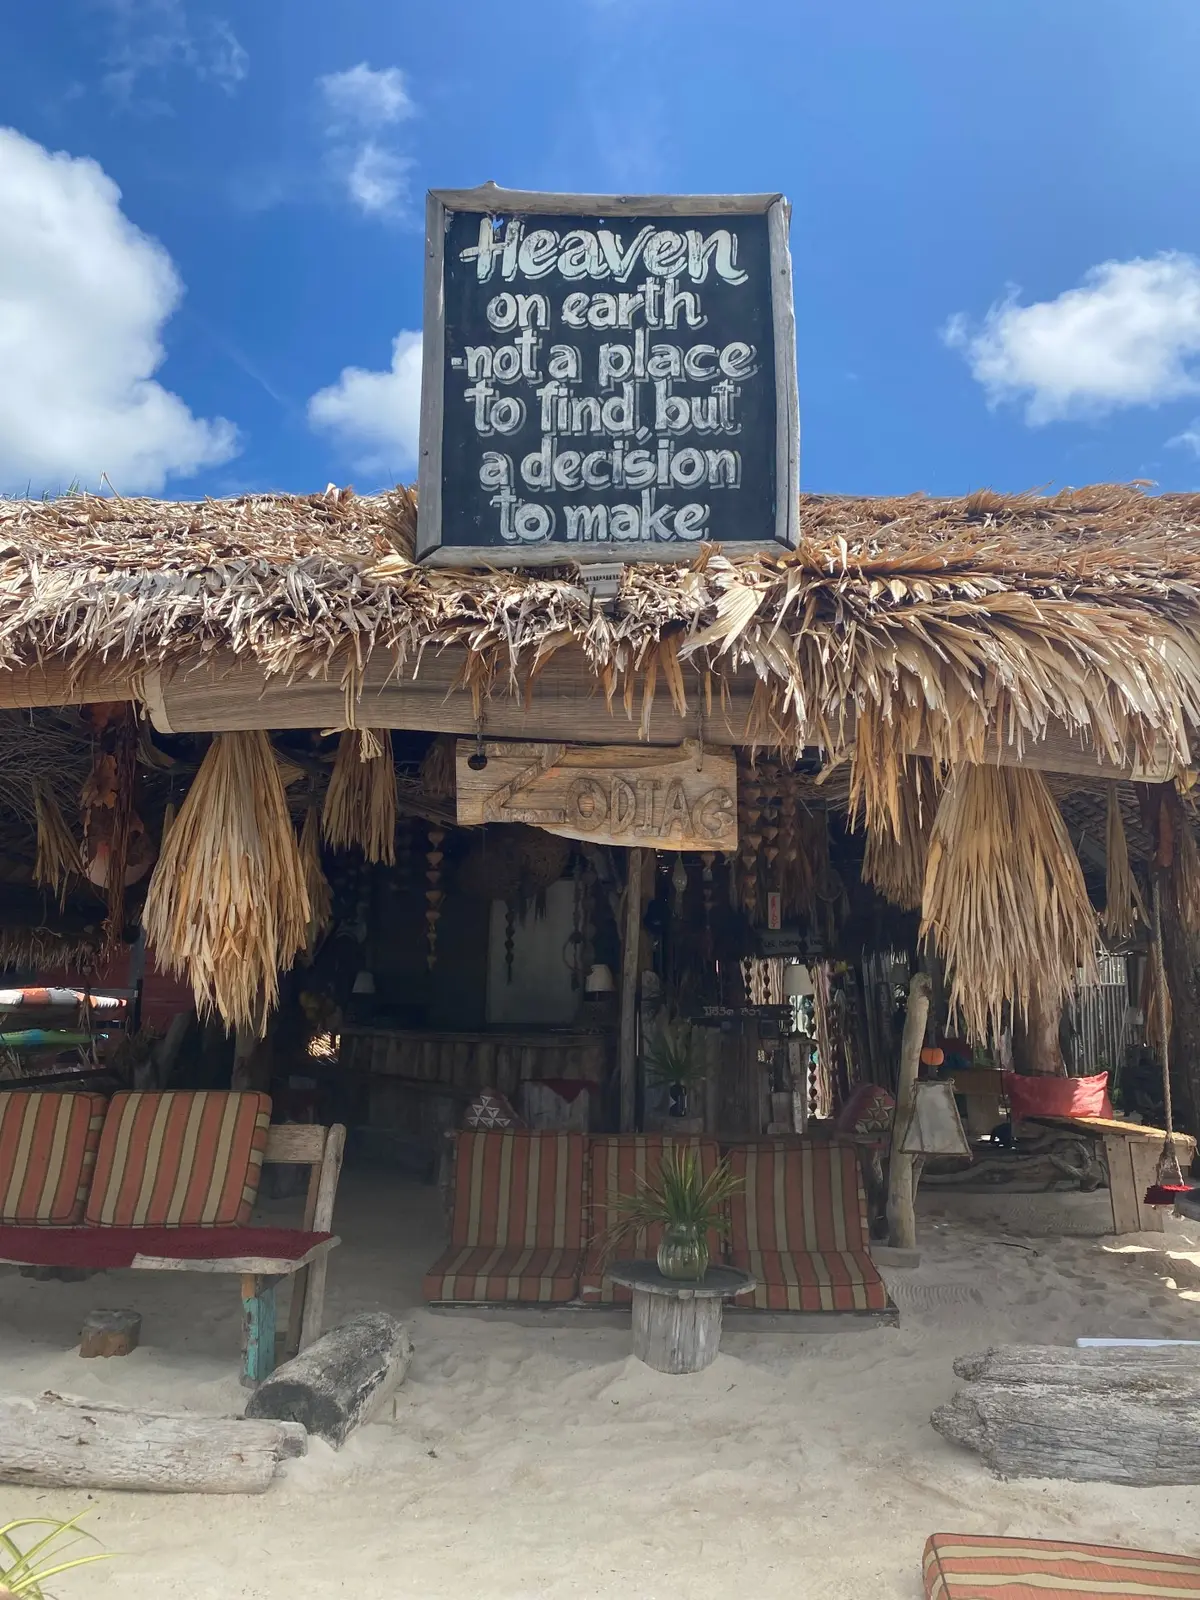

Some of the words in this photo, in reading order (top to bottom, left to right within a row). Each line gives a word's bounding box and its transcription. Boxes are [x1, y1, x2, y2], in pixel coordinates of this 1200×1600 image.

[459, 215, 749, 286] Heaven
[486, 291, 550, 332] on
[561, 276, 708, 332] earth
[547, 345, 582, 384] a
[598, 326, 758, 393] place
[464, 380, 527, 435] to
[654, 377, 742, 435] but
[478, 450, 514, 489] a
[520, 434, 742, 491] decision
[490, 489, 556, 544] to
[563, 488, 710, 544] make
